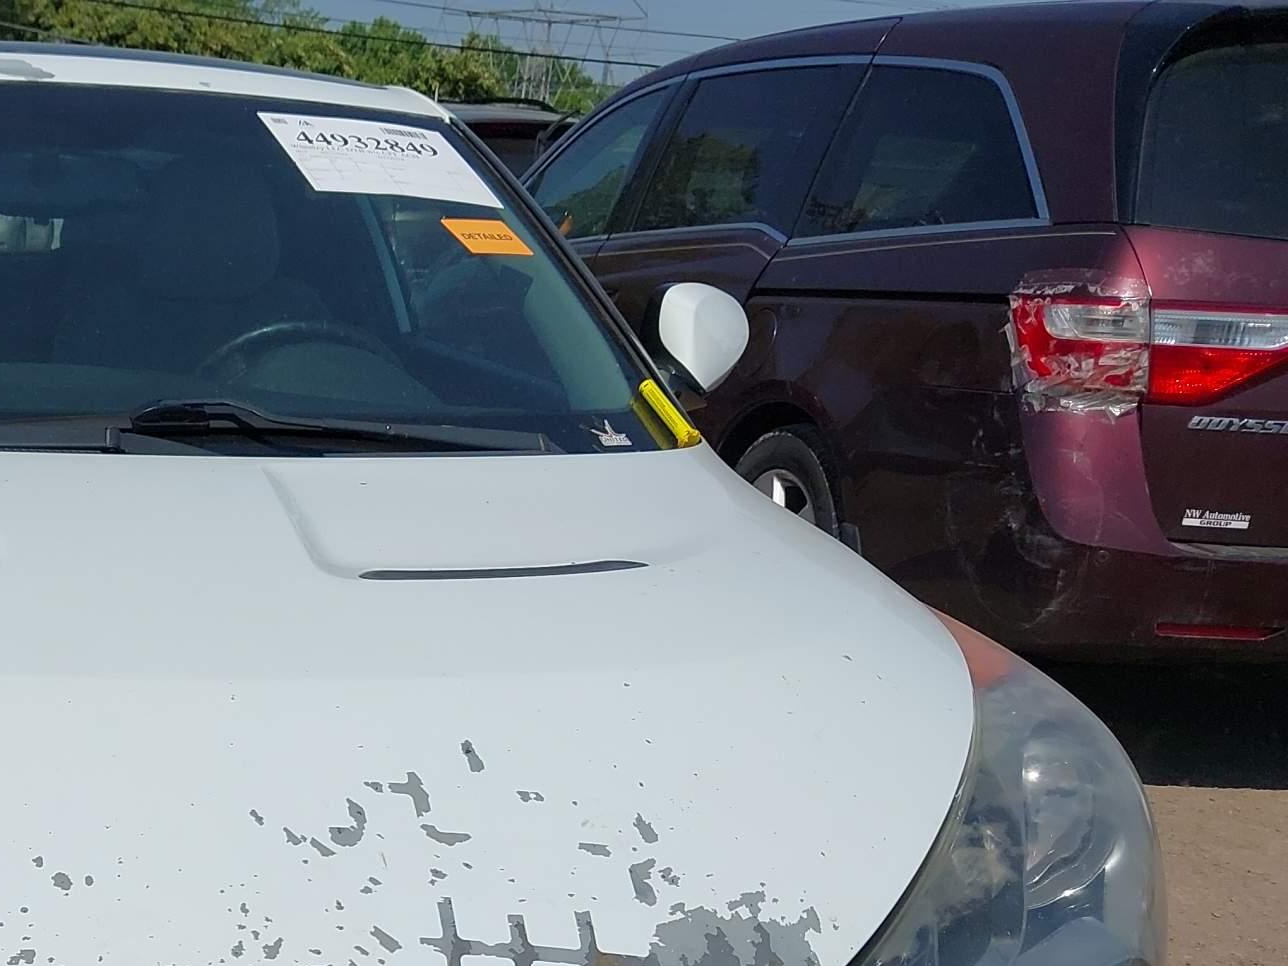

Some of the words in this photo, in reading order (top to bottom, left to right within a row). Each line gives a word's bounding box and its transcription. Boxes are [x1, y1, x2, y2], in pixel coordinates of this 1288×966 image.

[296, 131, 438, 157] 44932849
[460, 231, 512, 241] DETAILED
[1184, 508, 1202, 519] NW
[1202, 510, 1251, 522] Automotive
[1199, 519, 1232, 527] GROUP
